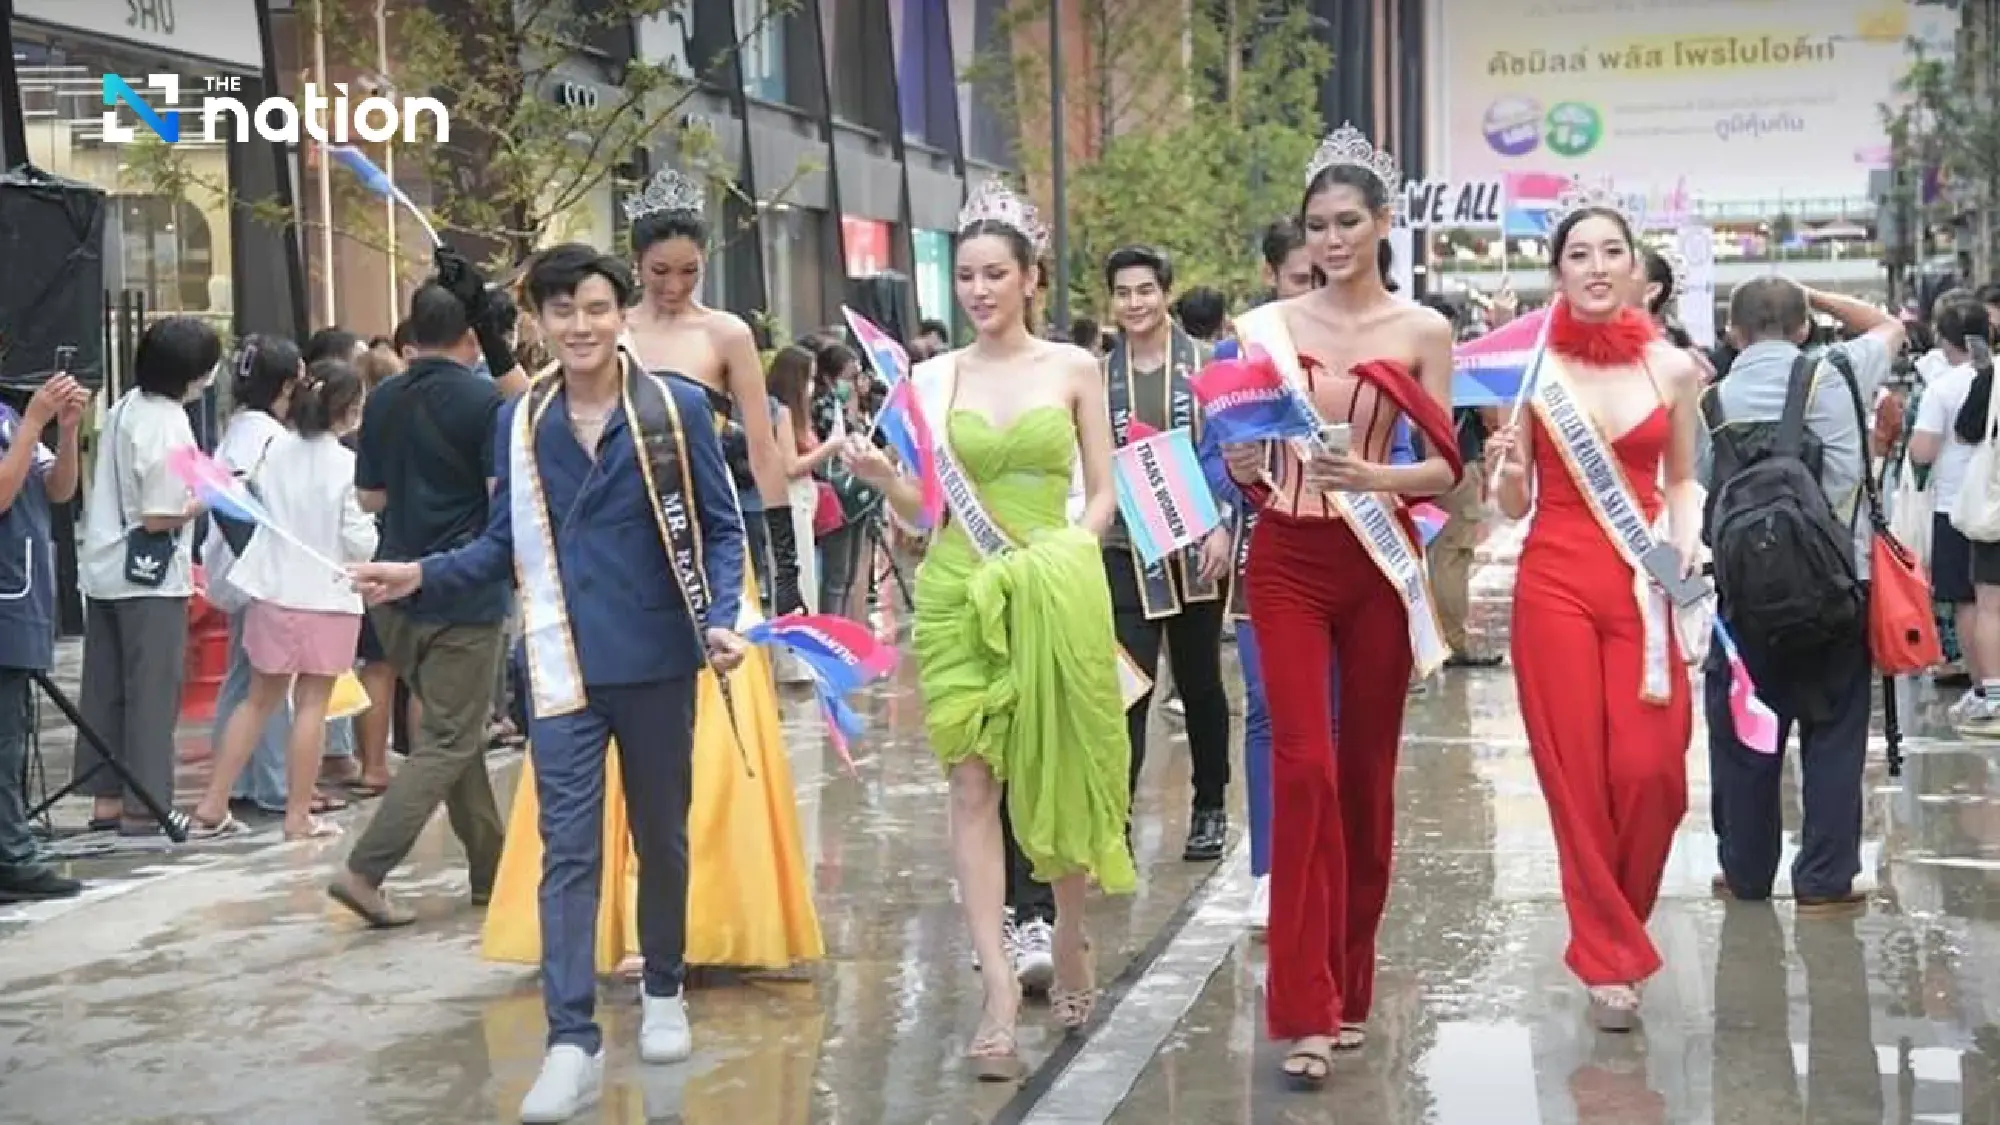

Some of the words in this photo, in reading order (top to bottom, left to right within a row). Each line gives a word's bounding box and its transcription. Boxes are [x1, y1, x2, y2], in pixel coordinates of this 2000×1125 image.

[1407, 182, 1448, 222] WE
[1453, 181, 1500, 222] ALL
[1137, 442, 1164, 488] TRANS
[1155, 486, 1187, 538] WOMEN
[661, 491, 688, 540] MR.
